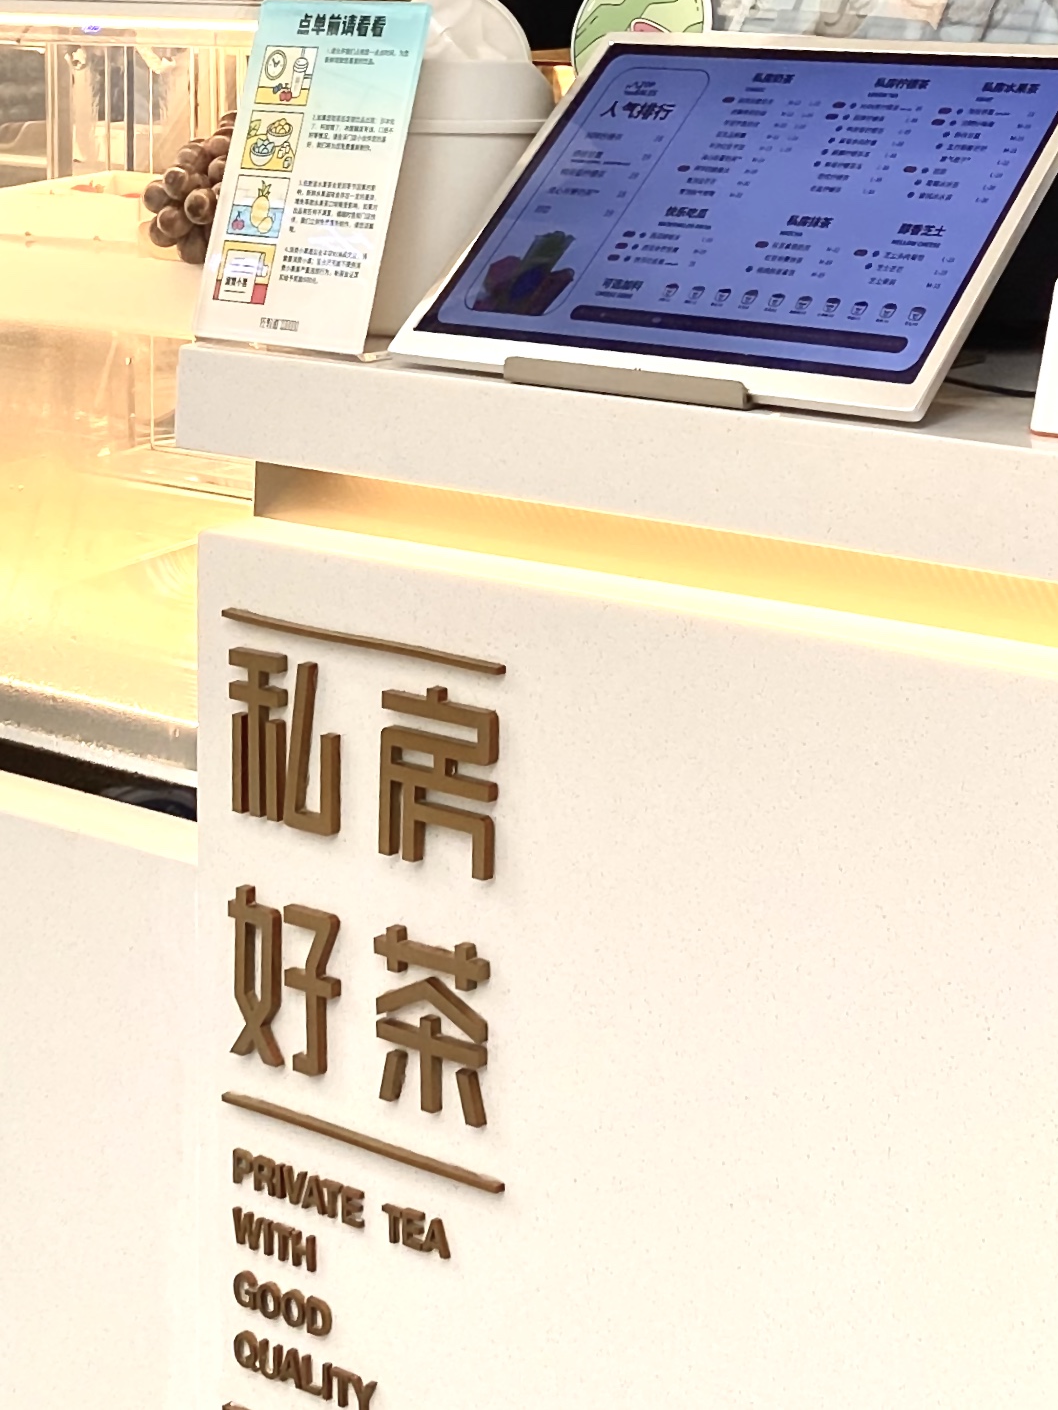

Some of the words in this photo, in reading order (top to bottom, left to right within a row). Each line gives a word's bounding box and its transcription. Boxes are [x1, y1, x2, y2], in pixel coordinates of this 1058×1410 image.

[297, 13, 386, 37] 点单前请看看
[600, 101, 676, 120] 人气排行
[229, 647, 499, 880] 私房
[228, 885, 490, 1127] 好茶
[232, 1206, 317, 1272] WITH
[233, 1147, 365, 1228] PRIVATE
[382, 1203, 451, 1259] TEA
[233, 1270, 332, 1336] GOOD
[233, 1330, 378, 1410] QUALITY
